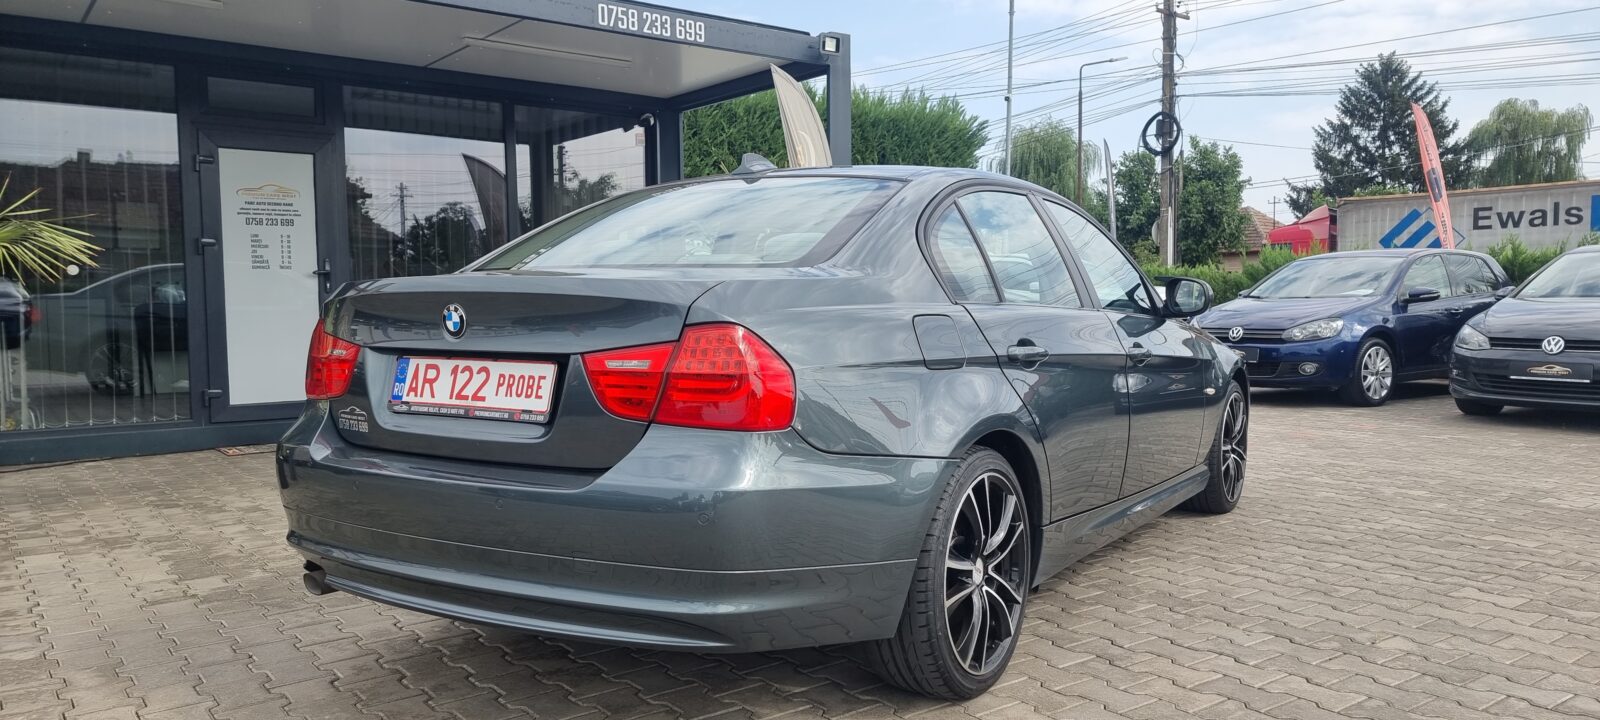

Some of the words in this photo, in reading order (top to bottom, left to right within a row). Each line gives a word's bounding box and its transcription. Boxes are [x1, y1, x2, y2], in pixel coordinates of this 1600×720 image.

[598, 3, 638, 31] 0758
[643, 12, 671, 37] 233
[676, 18, 705, 42] 699
[245, 217, 263, 226] 0758
[265, 217, 279, 227] 233
[280, 218, 295, 227] 699
[1473, 202, 1584, 230] Ewals
[393, 382, 405, 396] RO
[406, 363, 440, 398] AR
[449, 364, 491, 402] 122
[495, 373, 547, 399] PROBE
[339, 418, 349, 430] 0758
[350, 420, 358, 431] 233
[359, 421, 368, 432] 699
